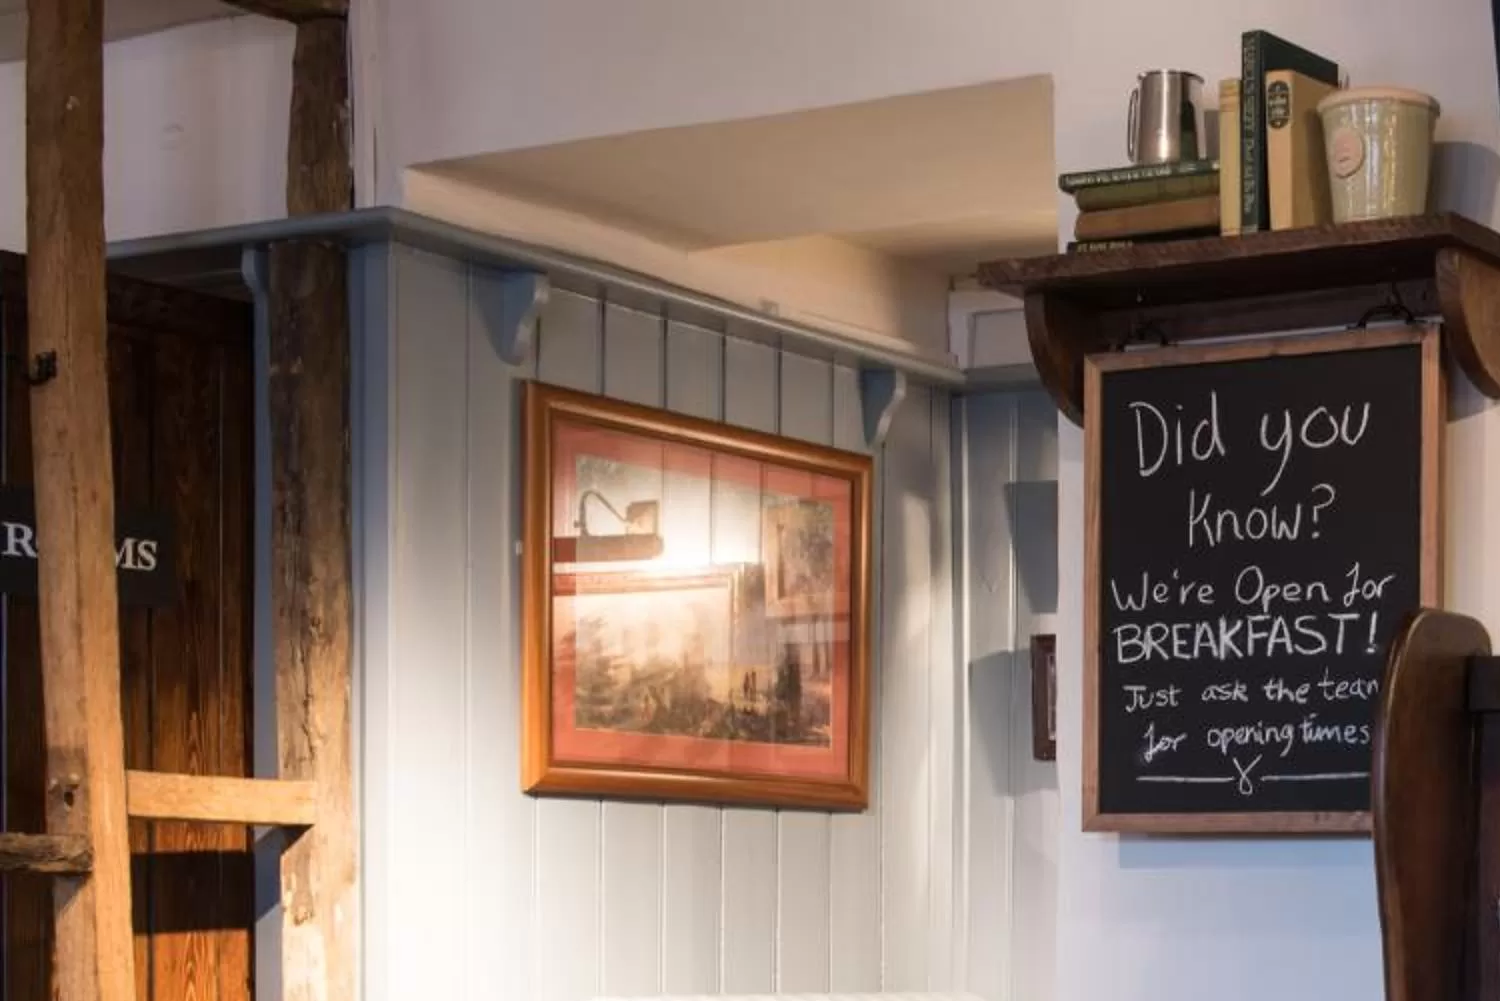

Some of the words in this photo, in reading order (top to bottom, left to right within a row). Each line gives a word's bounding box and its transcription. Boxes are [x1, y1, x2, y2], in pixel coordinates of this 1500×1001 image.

[1129, 389, 1226, 477] Did
[1259, 402, 1370, 497] you
[1188, 482, 1336, 548] Know?
[2, 521, 158, 571] RMS
[1111, 568, 1216, 611] We're
[1234, 565, 1331, 613] Open
[1342, 561, 1397, 607] for
[1112, 610, 1378, 664] BREAKFAST!
[1122, 684, 1182, 713] Just
[1200, 679, 1249, 702] ask
[1262, 676, 1311, 704] the
[1142, 721, 1188, 763] for
[1206, 720, 1296, 757] opening
[1299, 712, 1371, 745] times
